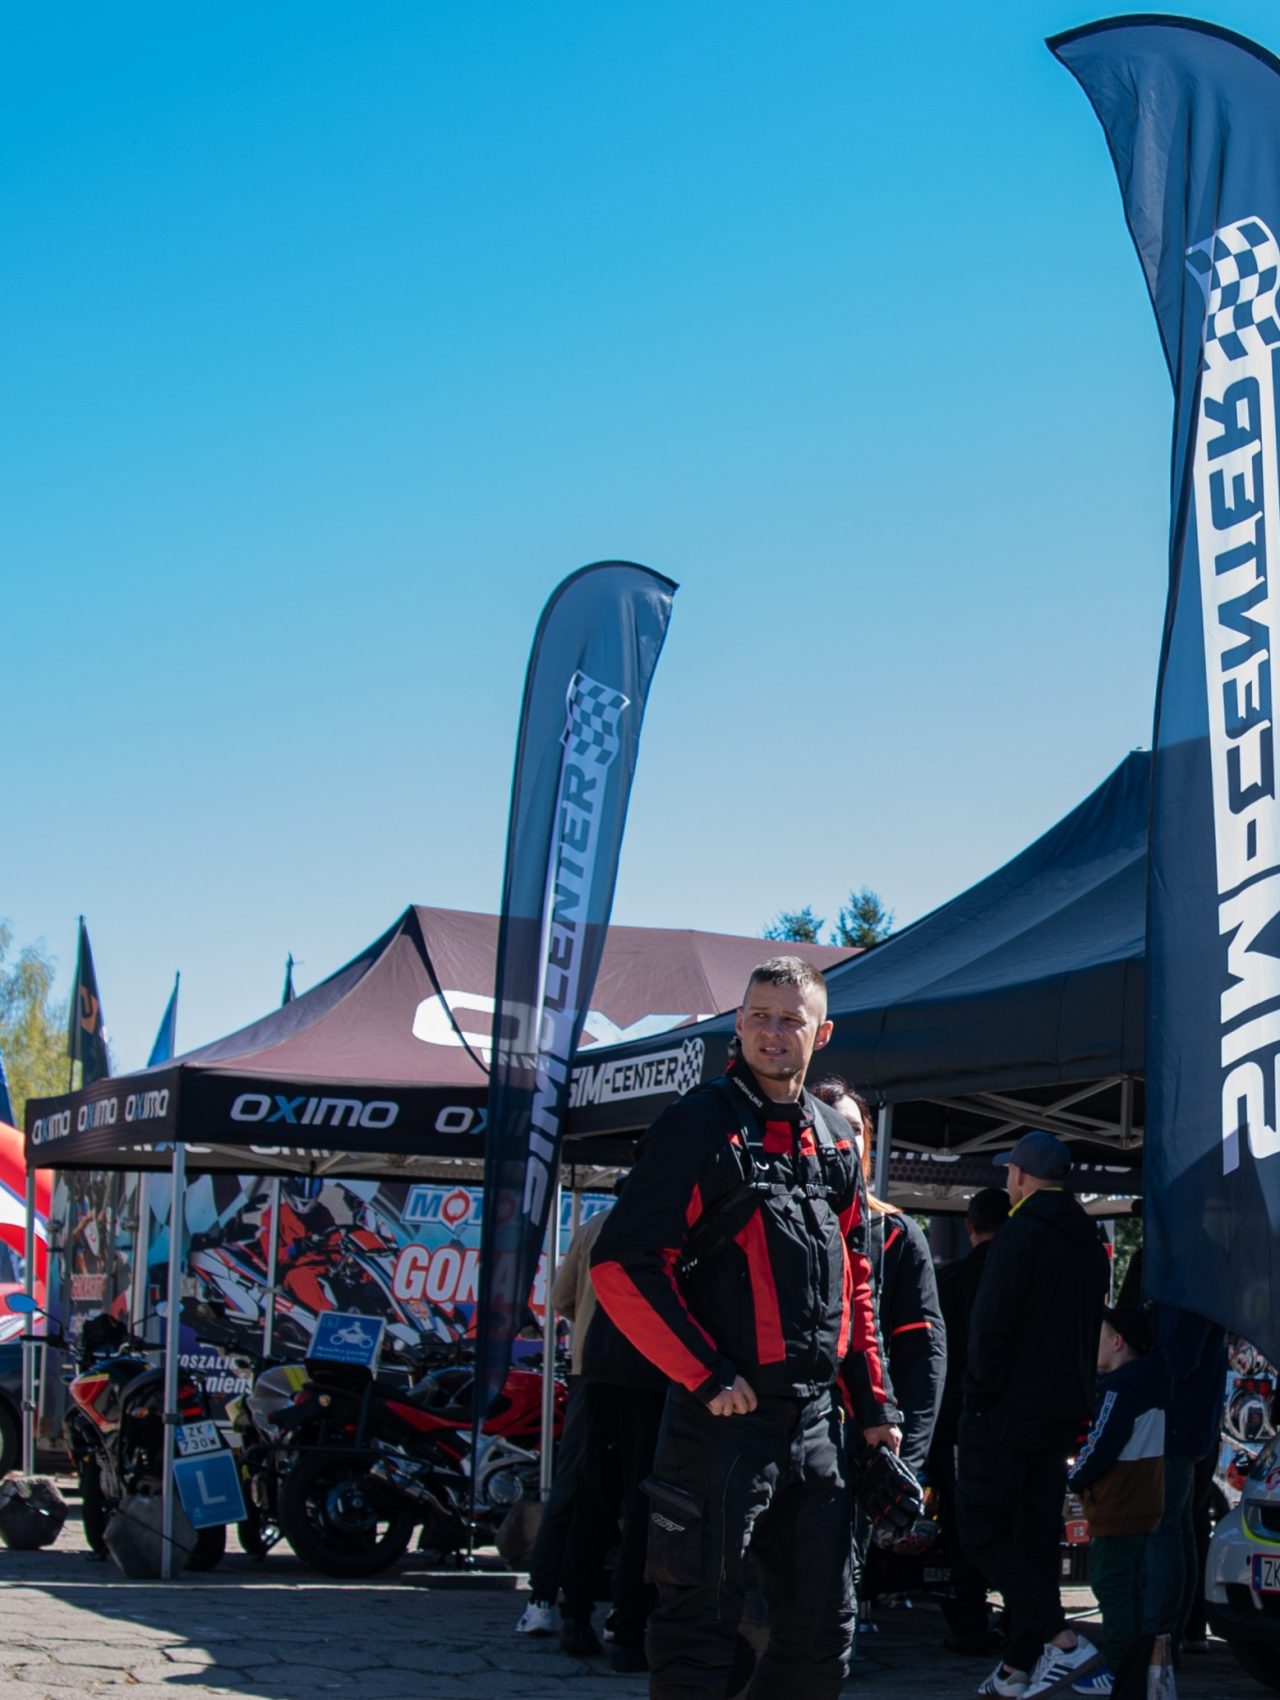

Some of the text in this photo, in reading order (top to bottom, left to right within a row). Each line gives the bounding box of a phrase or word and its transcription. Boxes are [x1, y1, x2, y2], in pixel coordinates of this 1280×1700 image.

[125, 1088, 170, 1121] OXIMO
[230, 1093, 400, 1129] OXIMO
[195, 1470, 227, 1505] L
